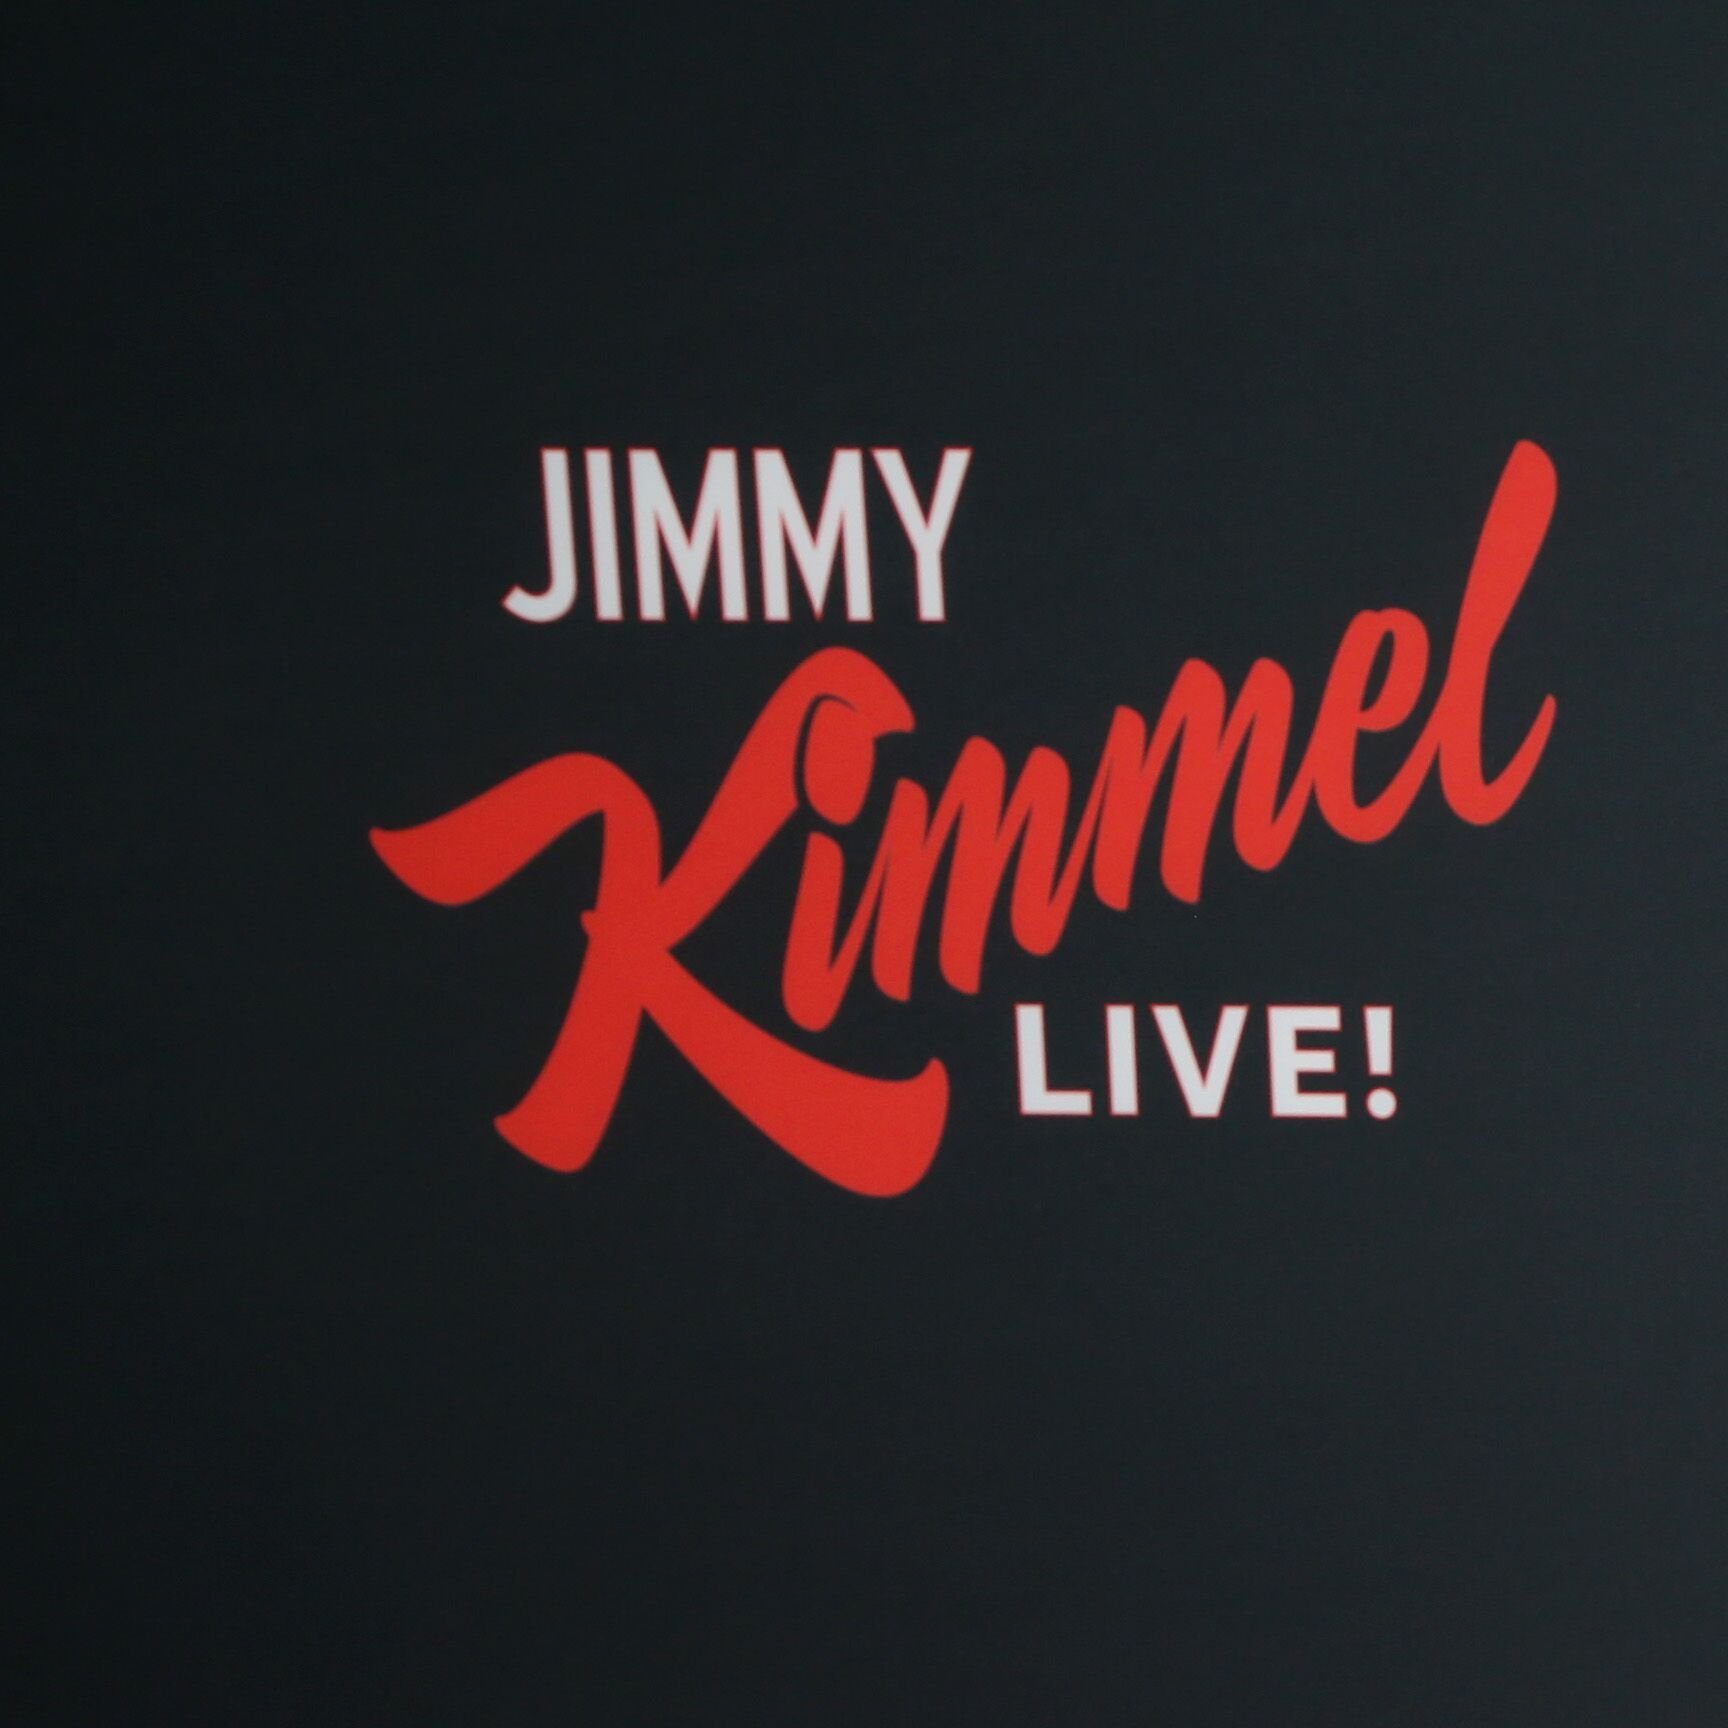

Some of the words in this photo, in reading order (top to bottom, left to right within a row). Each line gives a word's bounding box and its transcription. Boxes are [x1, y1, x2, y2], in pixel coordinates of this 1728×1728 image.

[501, 447, 973, 624] JIMMY
[369, 438, 1560, 1199] Kimmel
[1014, 1002, 1398, 1121] LIVE!
